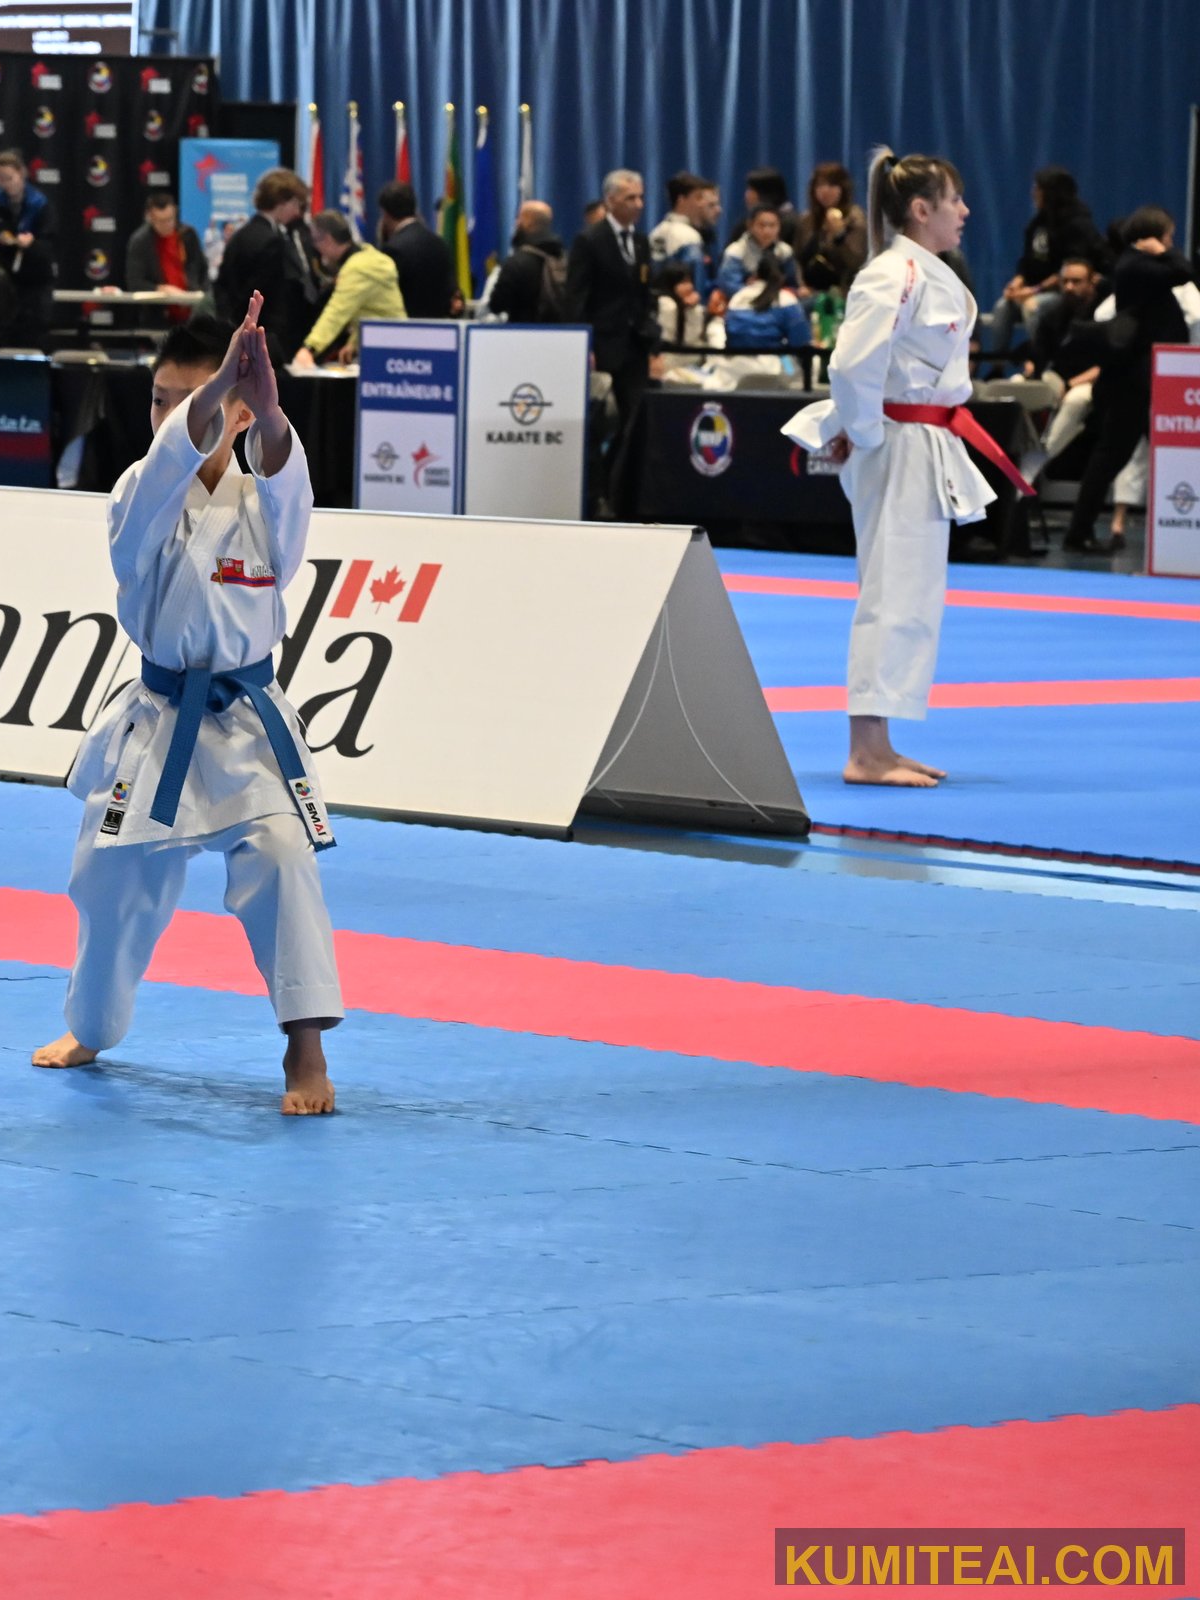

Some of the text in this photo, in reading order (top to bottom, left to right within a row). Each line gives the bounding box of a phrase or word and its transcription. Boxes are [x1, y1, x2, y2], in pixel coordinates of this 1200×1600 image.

[385, 358, 433, 376] COACH
[486, 430, 564, 446] KARATE BC
[304, 801, 327, 836] SMAI
